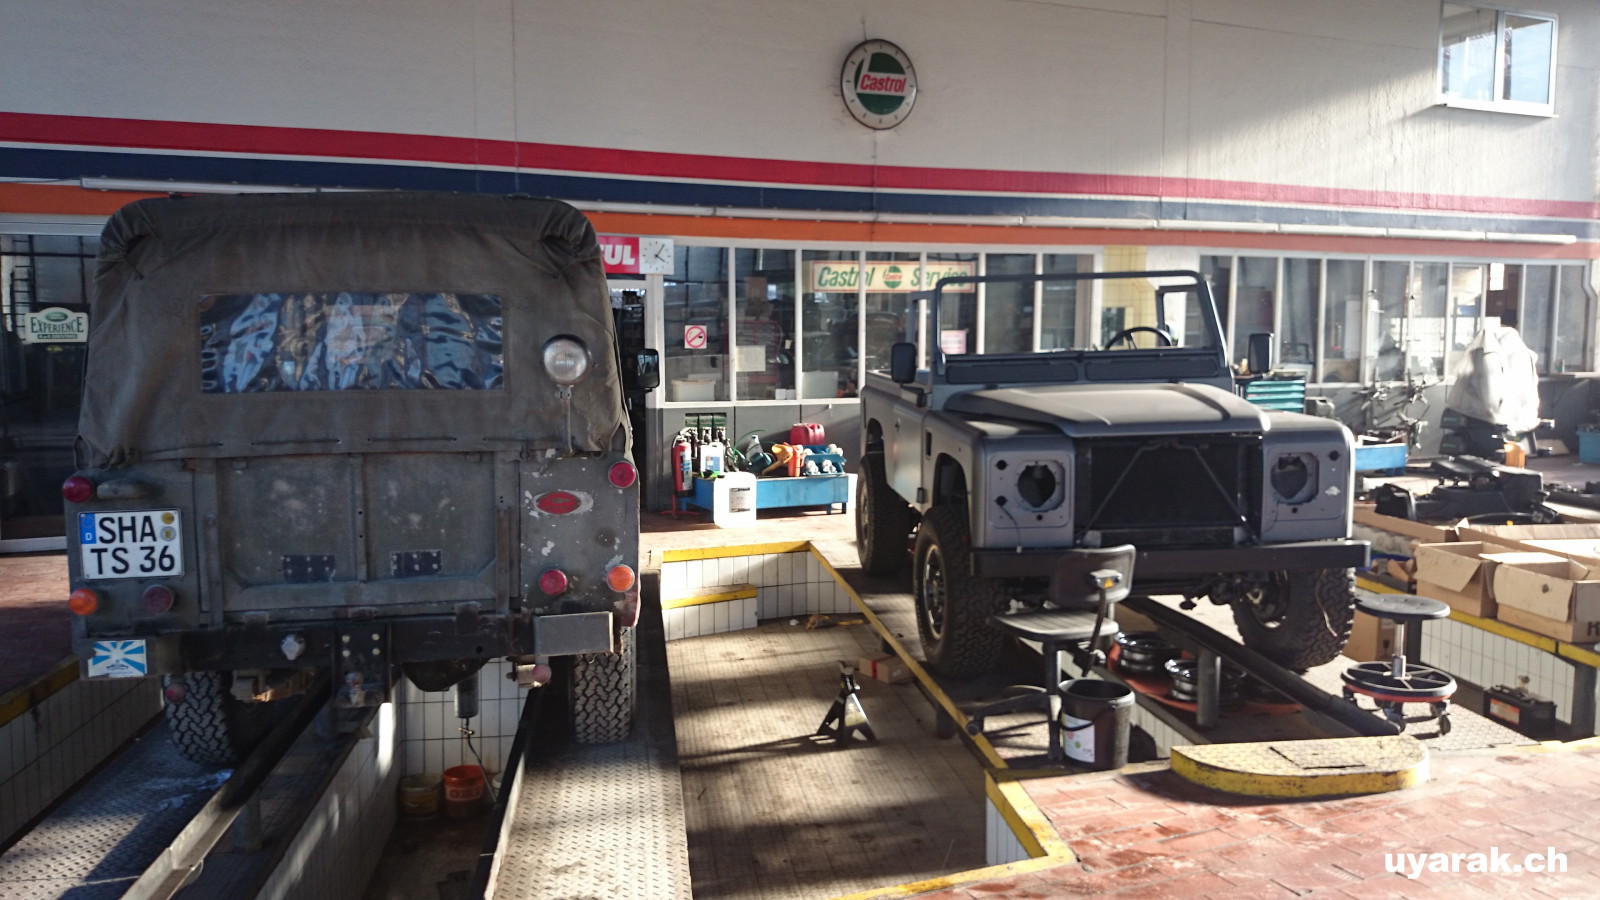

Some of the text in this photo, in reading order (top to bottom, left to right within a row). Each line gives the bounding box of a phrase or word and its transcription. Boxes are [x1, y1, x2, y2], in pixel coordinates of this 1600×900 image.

[860, 74, 906, 93] Castrol
[30, 316, 84, 333] EXPERIENCE
[85, 533, 92, 541] D
[98, 515, 157, 544] SHA
[90, 545, 175, 574] TS 36
